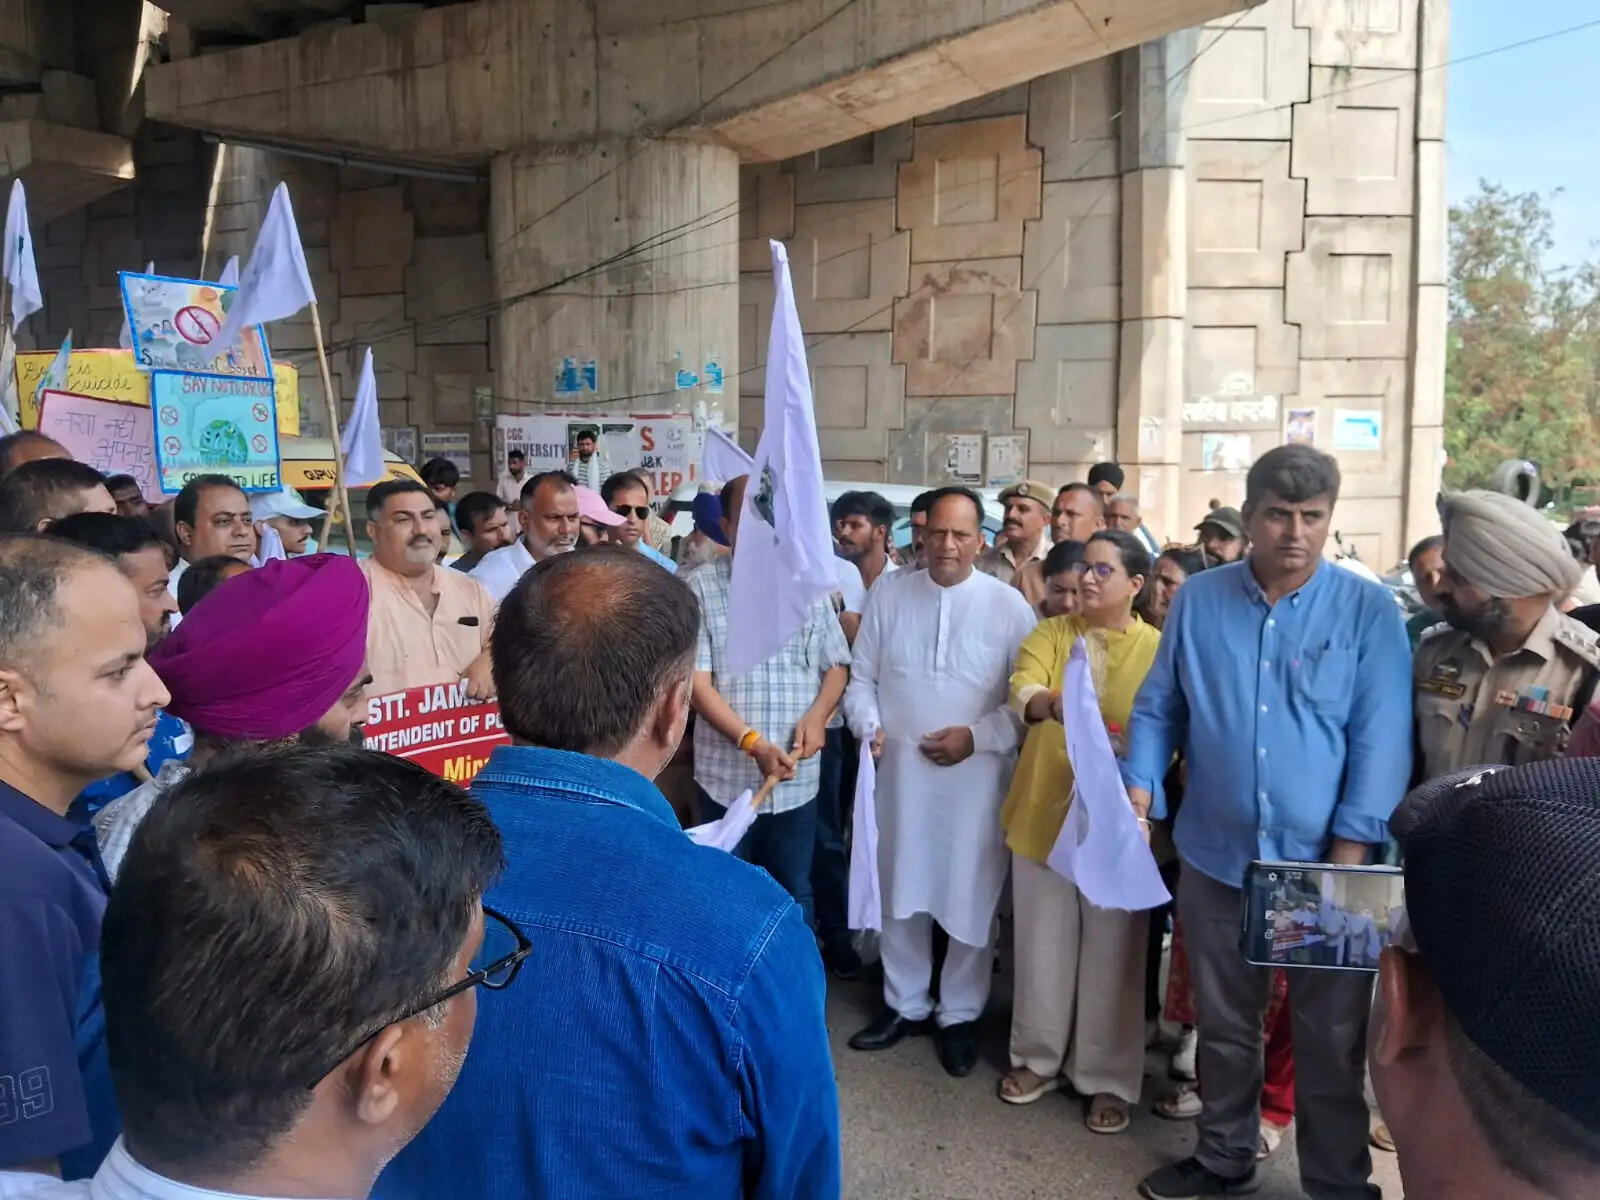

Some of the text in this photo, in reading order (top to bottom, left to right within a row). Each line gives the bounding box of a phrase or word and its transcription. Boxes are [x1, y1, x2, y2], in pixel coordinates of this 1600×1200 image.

[182, 375, 207, 394] SAY
[640, 456, 663, 468] J&K
[251, 472, 277, 488] LIFE
[459, 714, 480, 735] OF
